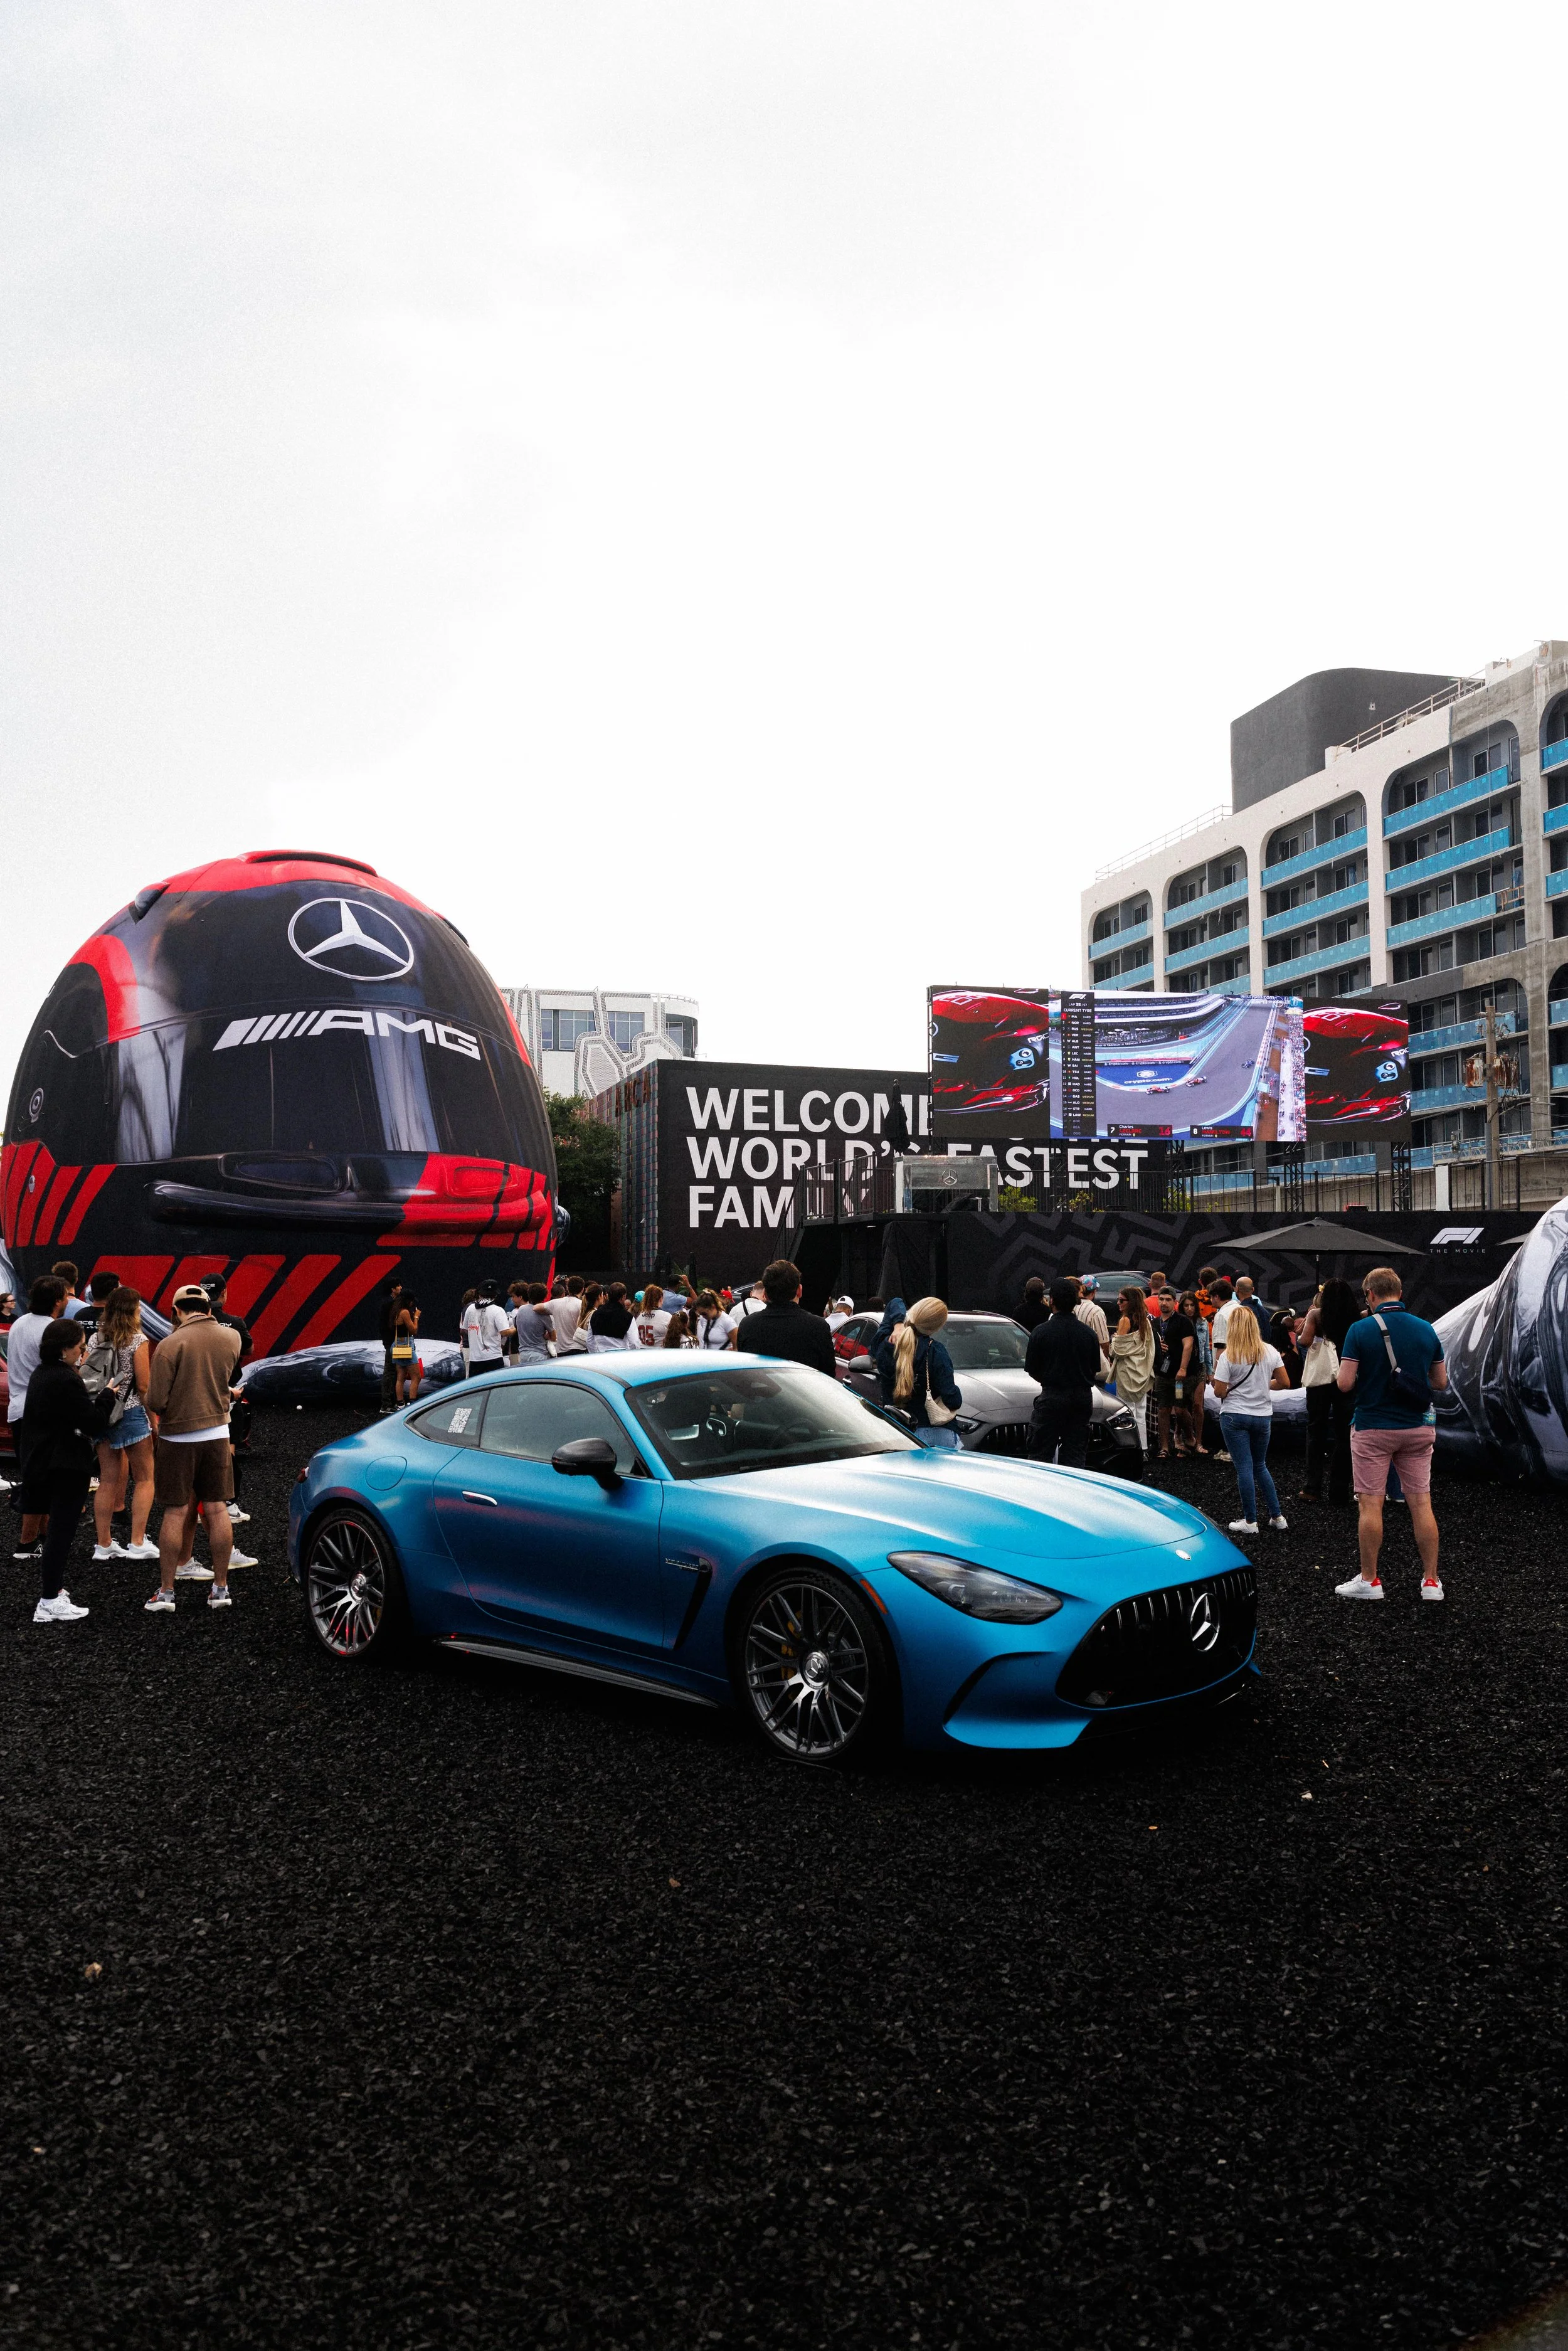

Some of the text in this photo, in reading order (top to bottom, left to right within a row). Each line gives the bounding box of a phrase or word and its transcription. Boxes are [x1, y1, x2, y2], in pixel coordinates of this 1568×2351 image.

[307, 1009, 480, 1061] AMG
[615, 1071, 650, 1117] ARCA
[1430, 1228, 1485, 1244] F1
[638, 1325, 655, 1346] 05
